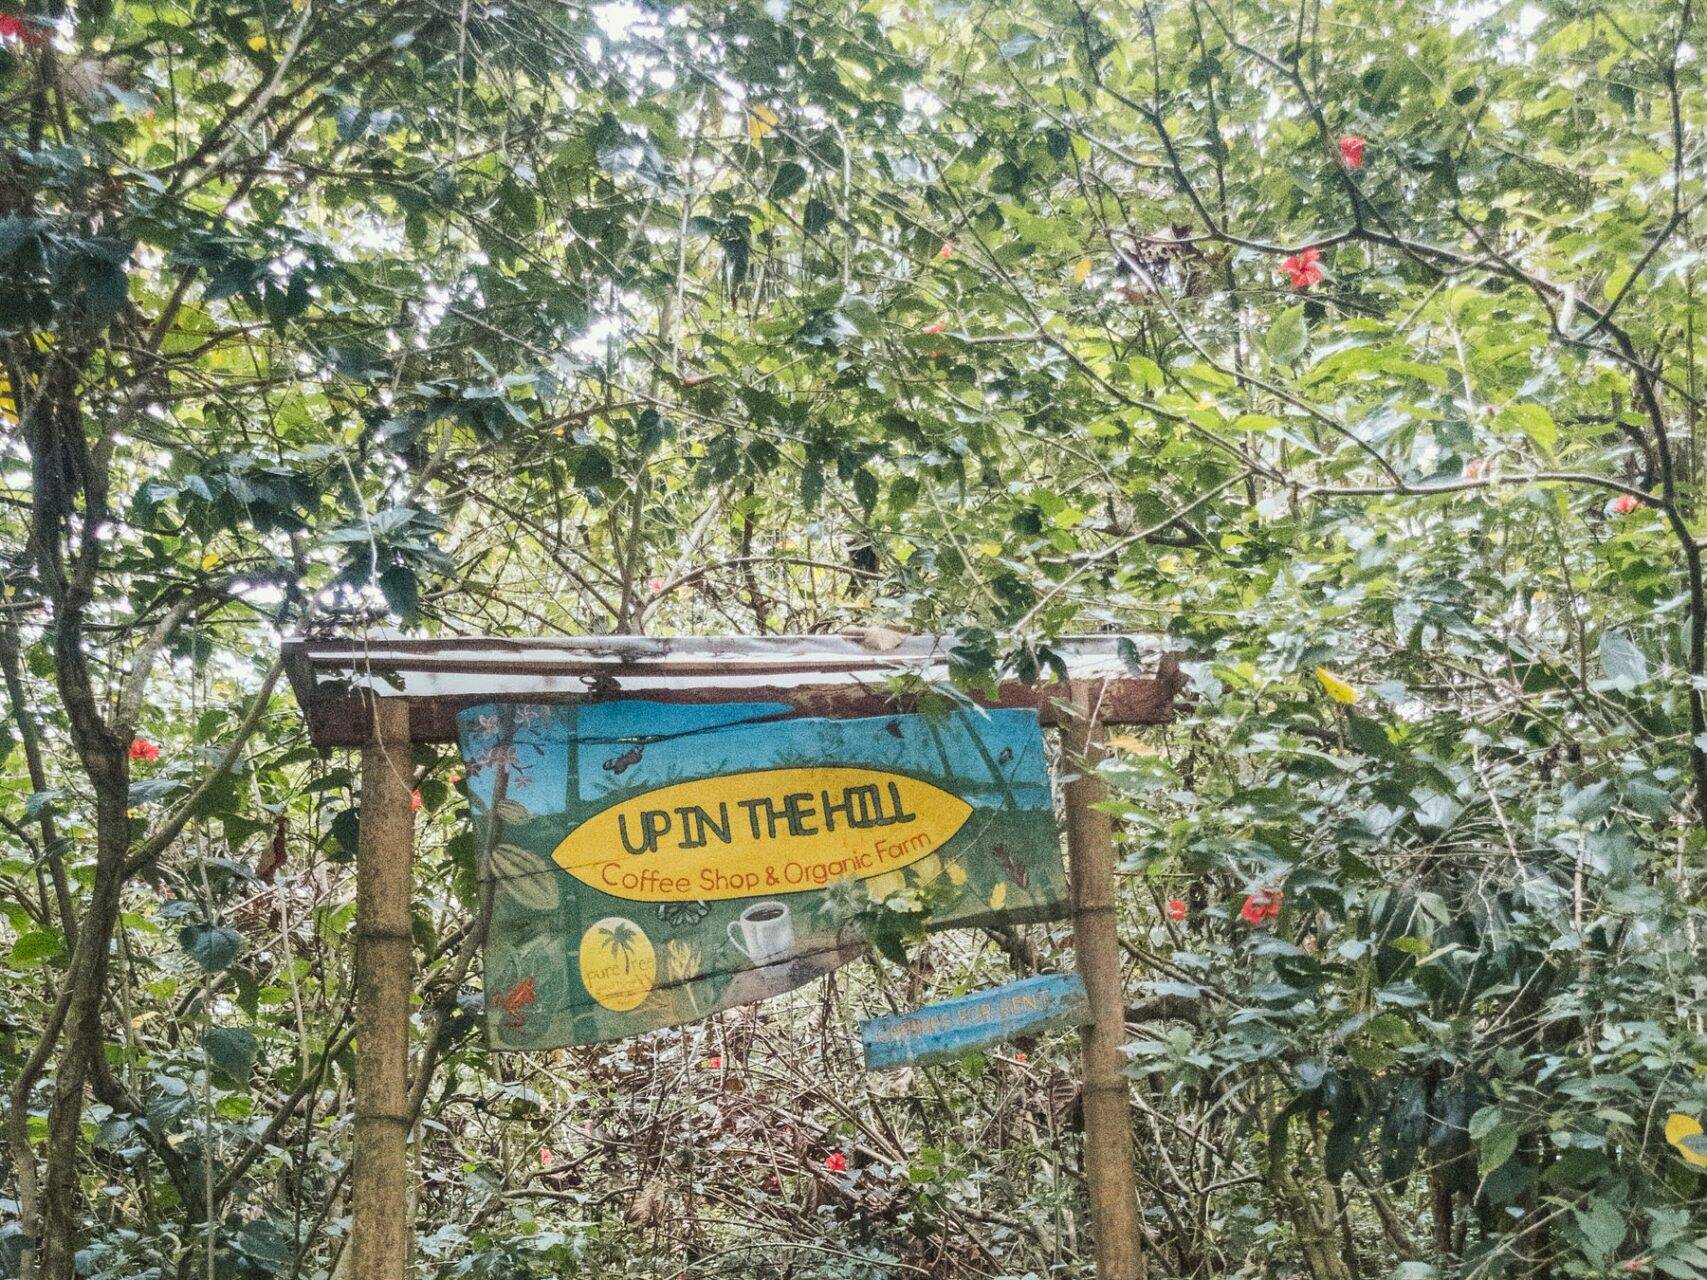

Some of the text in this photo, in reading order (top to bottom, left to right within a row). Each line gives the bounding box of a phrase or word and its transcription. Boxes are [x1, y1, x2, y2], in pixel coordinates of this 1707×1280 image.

[737, 790, 820, 841] THE
[821, 781, 917, 832] HILL
[601, 832, 932, 894] Coffee Shop & Organic Farm
[956, 1002, 993, 1026] FOR
